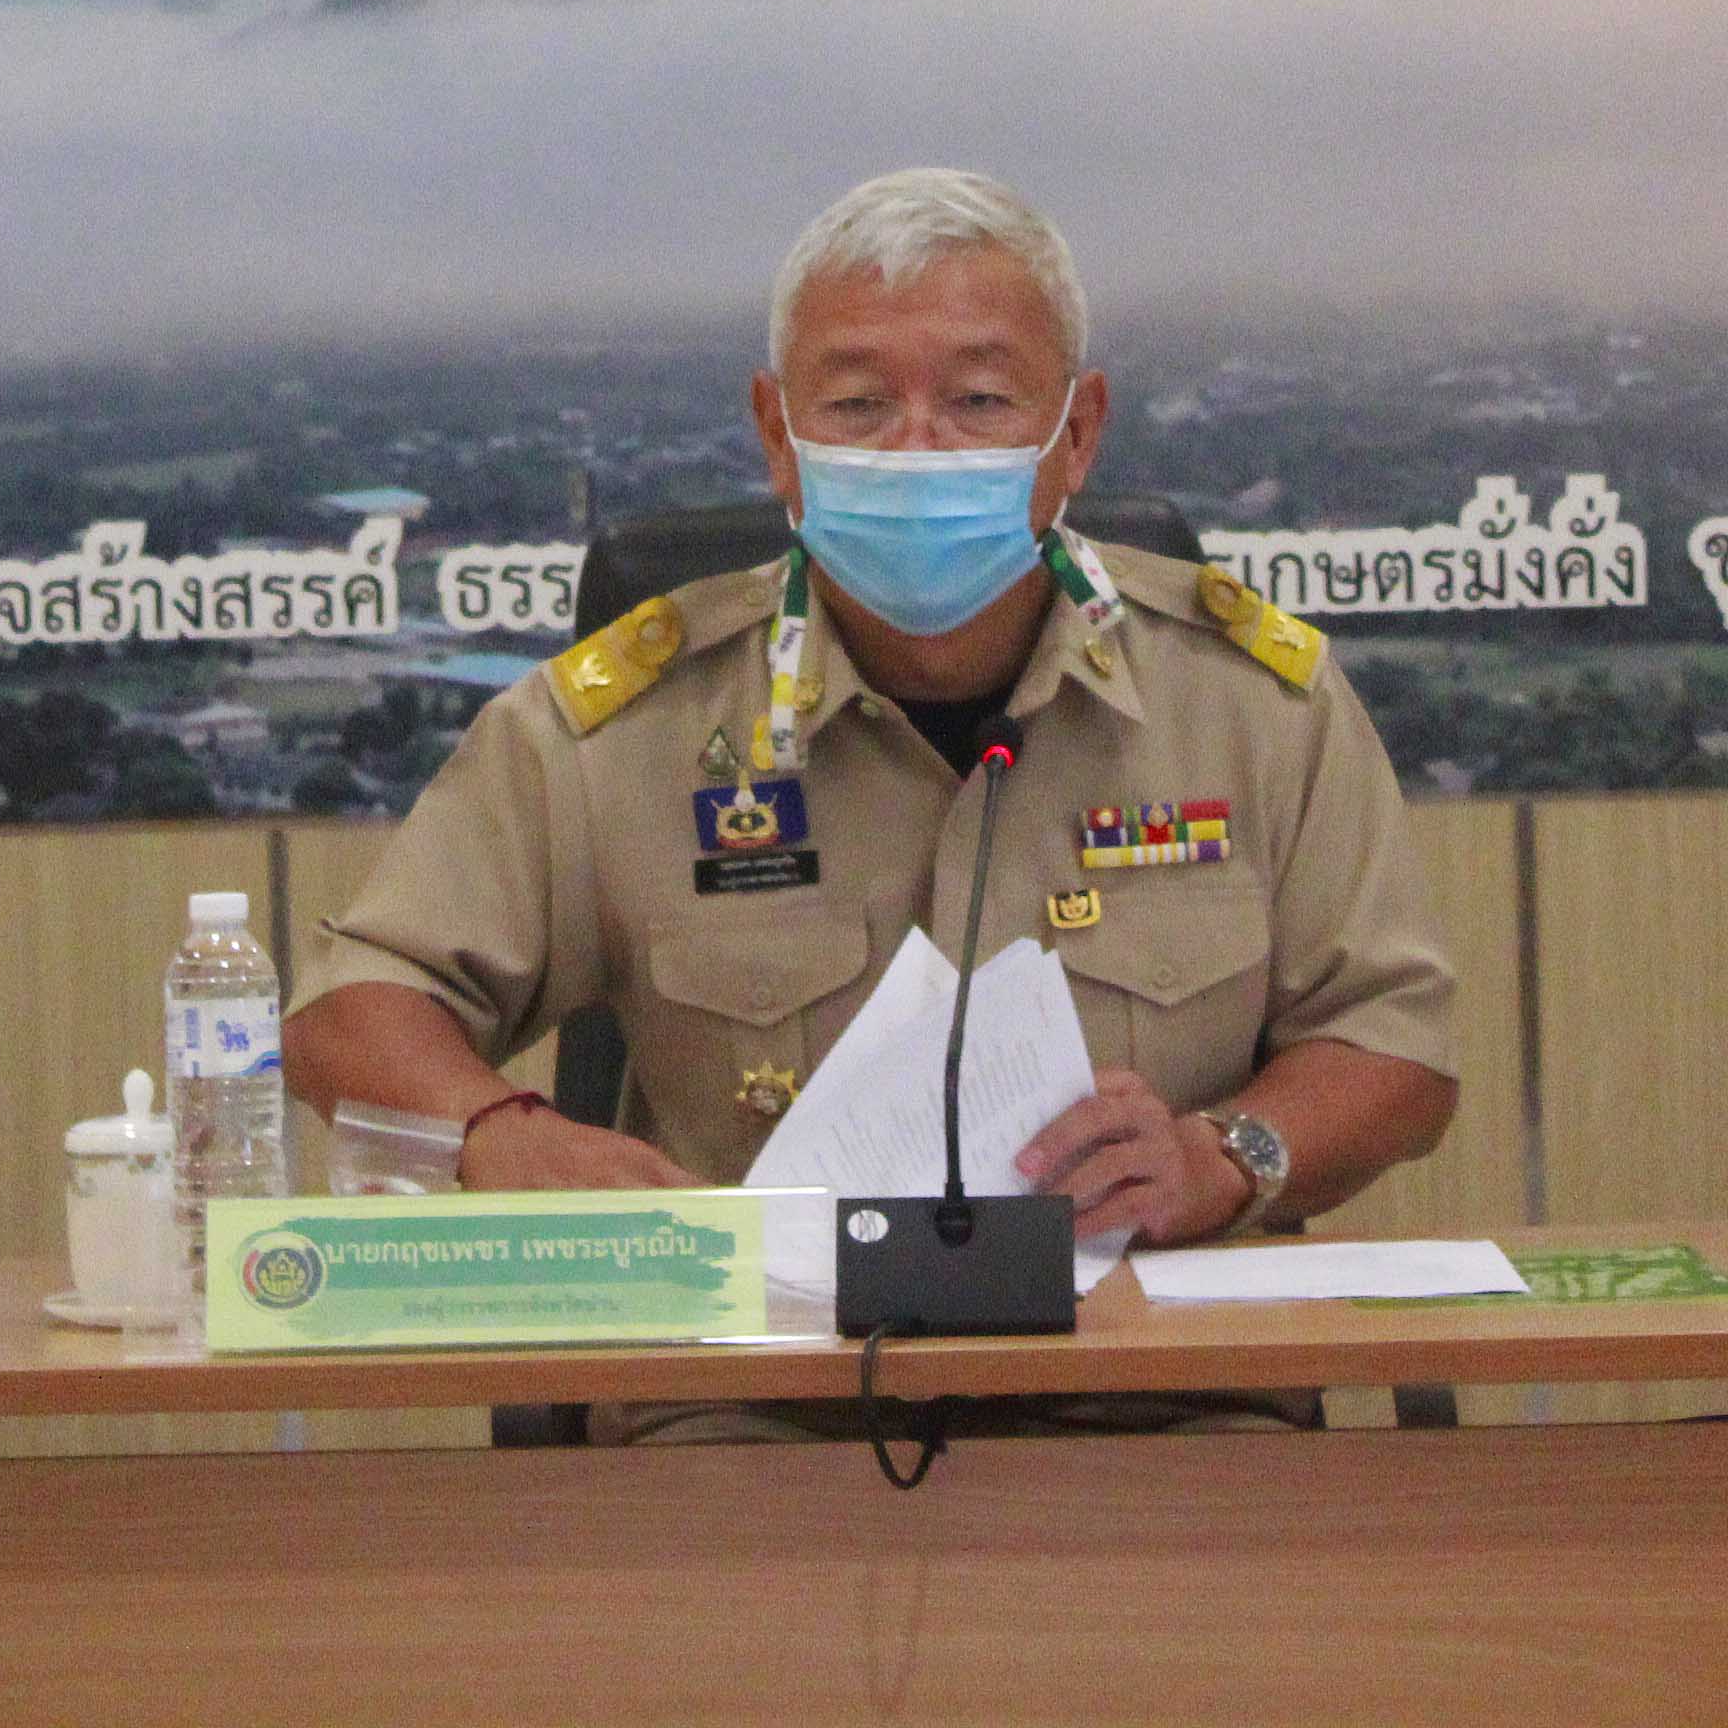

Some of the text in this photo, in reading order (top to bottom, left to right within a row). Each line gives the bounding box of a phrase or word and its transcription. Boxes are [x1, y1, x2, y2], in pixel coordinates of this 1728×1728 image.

[1204, 495, 1637, 605] เกษตรมั่งคั่ง
